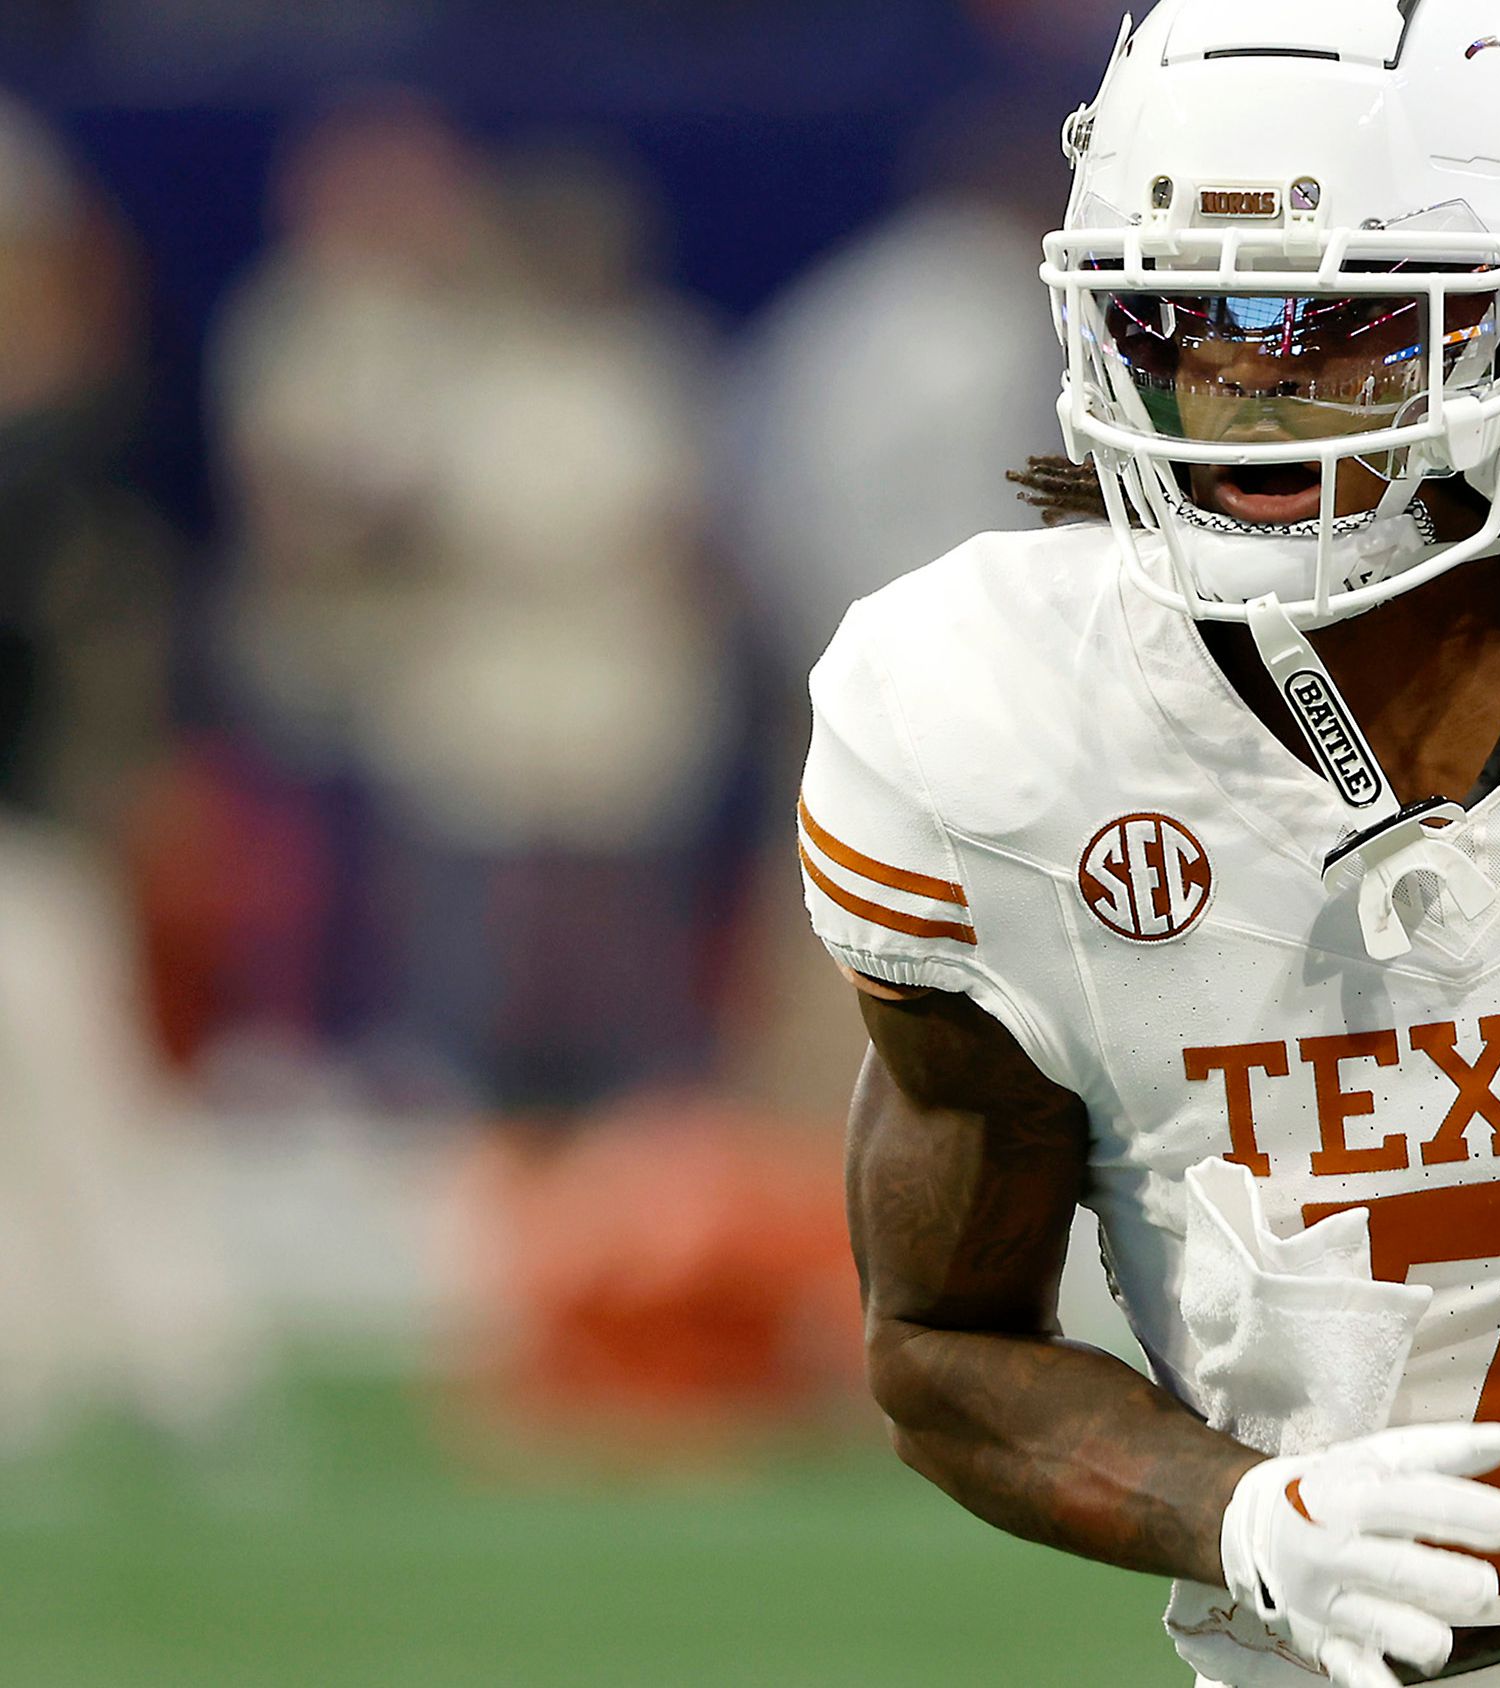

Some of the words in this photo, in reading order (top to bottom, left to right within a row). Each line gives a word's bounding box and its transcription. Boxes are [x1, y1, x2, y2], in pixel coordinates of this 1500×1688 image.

[1200, 191, 1275, 213] HORNS
[1294, 680, 1373, 796] BATTLE
[1085, 820, 1204, 935] SEC
